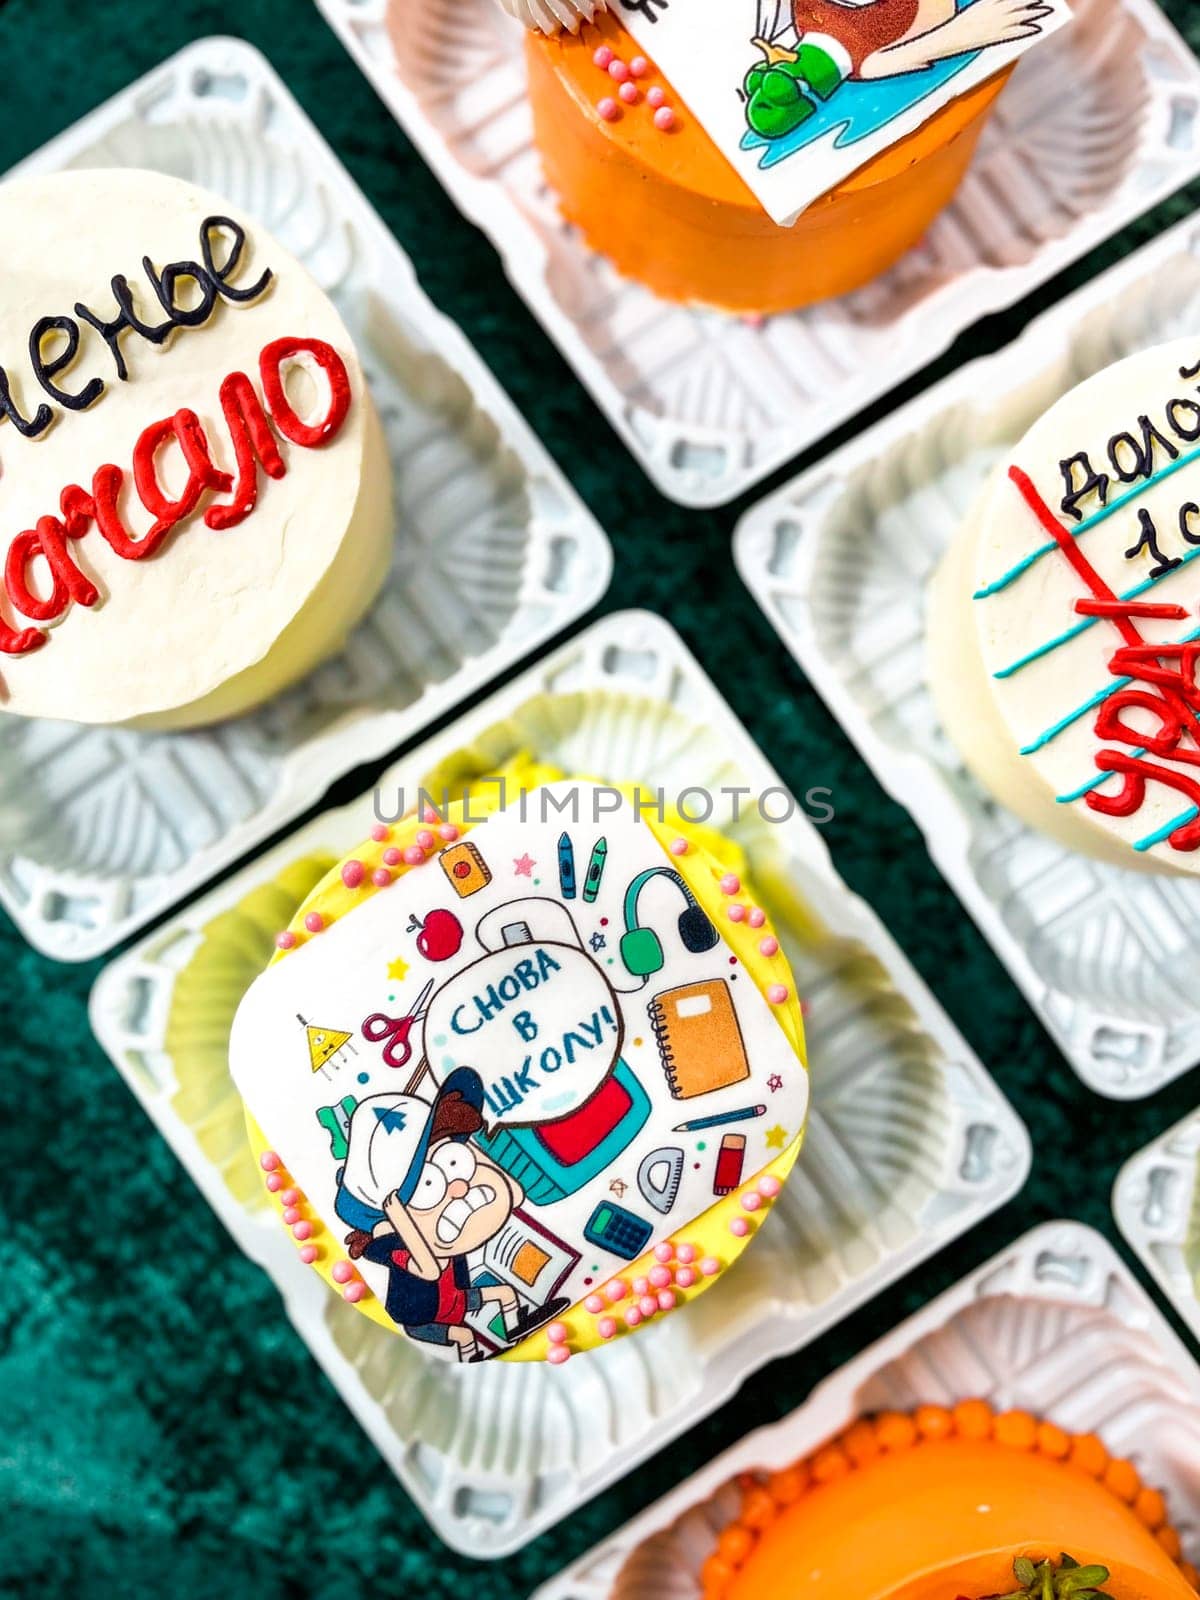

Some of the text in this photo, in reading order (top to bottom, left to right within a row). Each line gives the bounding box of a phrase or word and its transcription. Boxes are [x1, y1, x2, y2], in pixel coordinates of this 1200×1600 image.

[0, 336, 352, 654] ачало
[451, 949, 562, 1035] СНОВА
[512, 1010, 539, 1042] В
[482, 1005, 618, 1117] ШКОЛУ!
